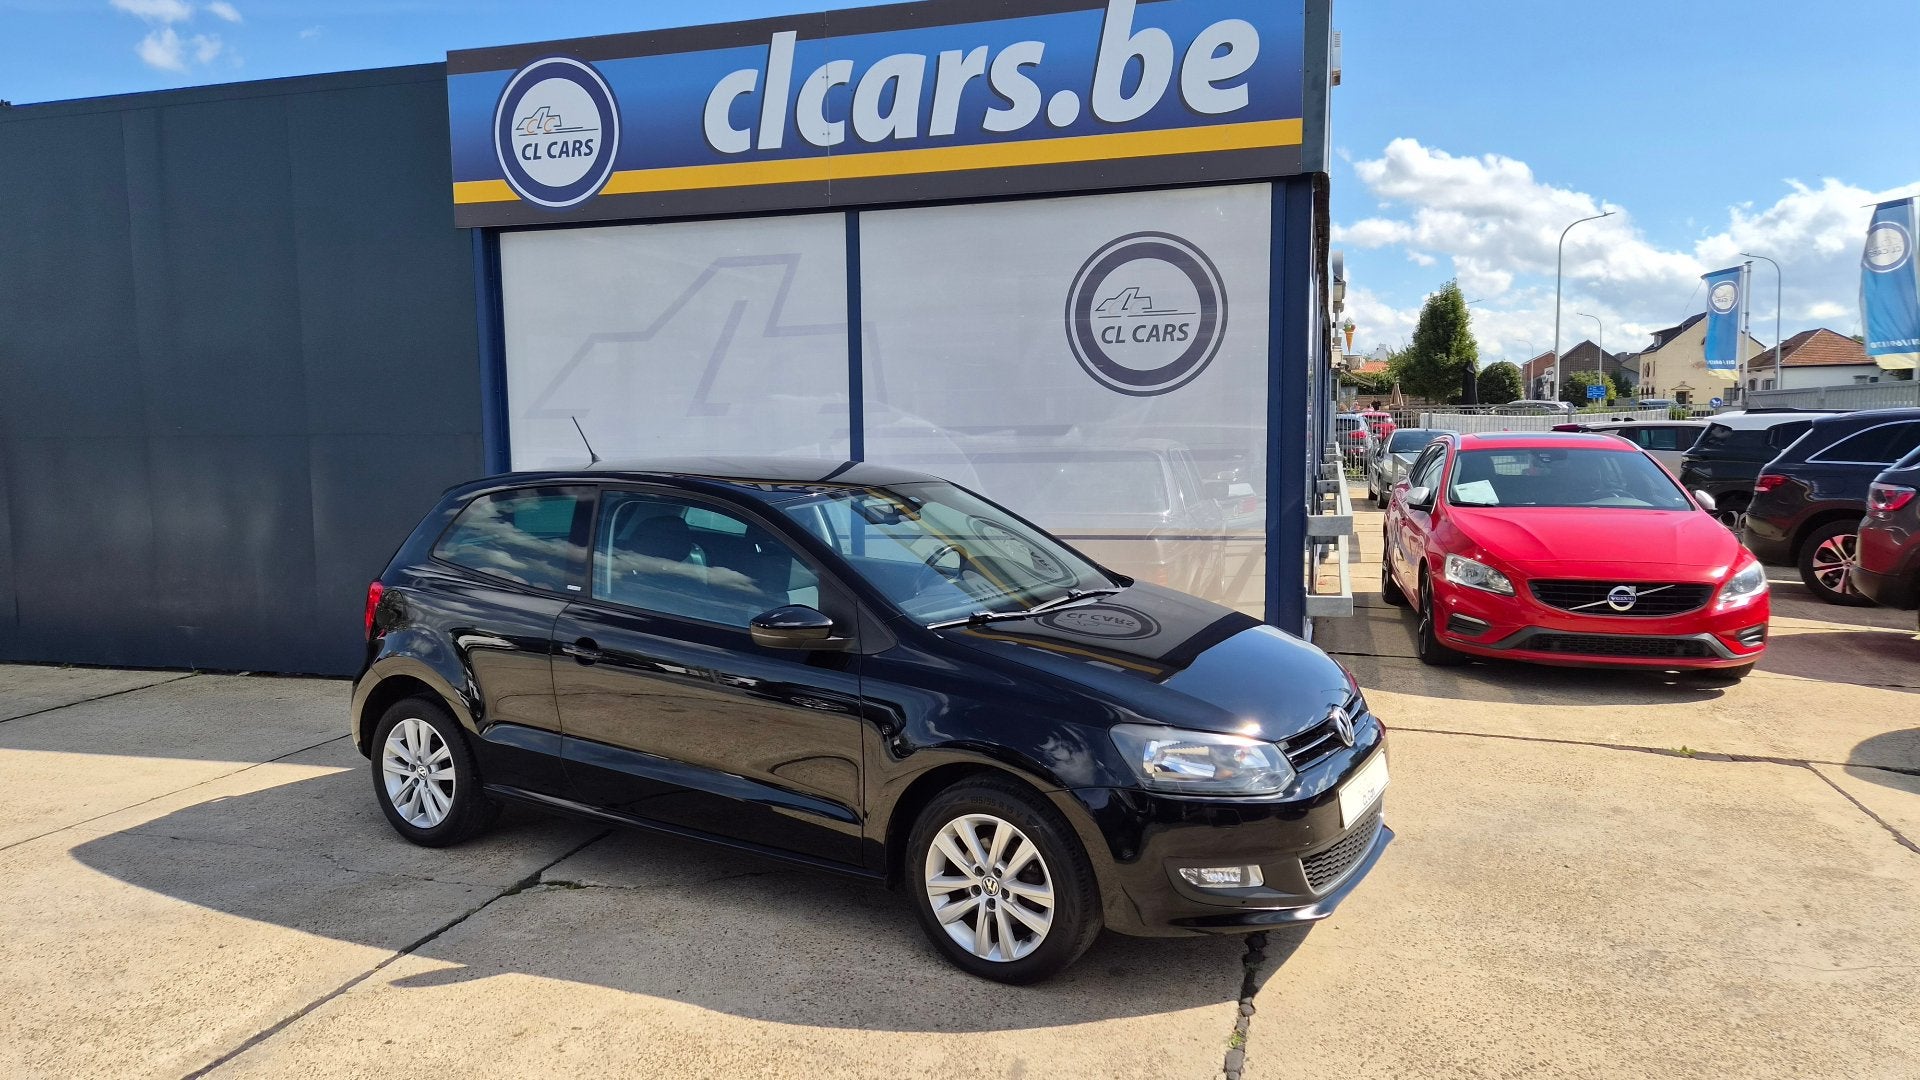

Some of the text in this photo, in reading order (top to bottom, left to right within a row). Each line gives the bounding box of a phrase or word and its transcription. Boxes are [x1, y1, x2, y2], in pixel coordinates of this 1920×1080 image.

[704, 0, 1260, 154] clcars.be
[521, 138, 594, 160] CL CARS
[1101, 322, 1189, 344] CL CARS
